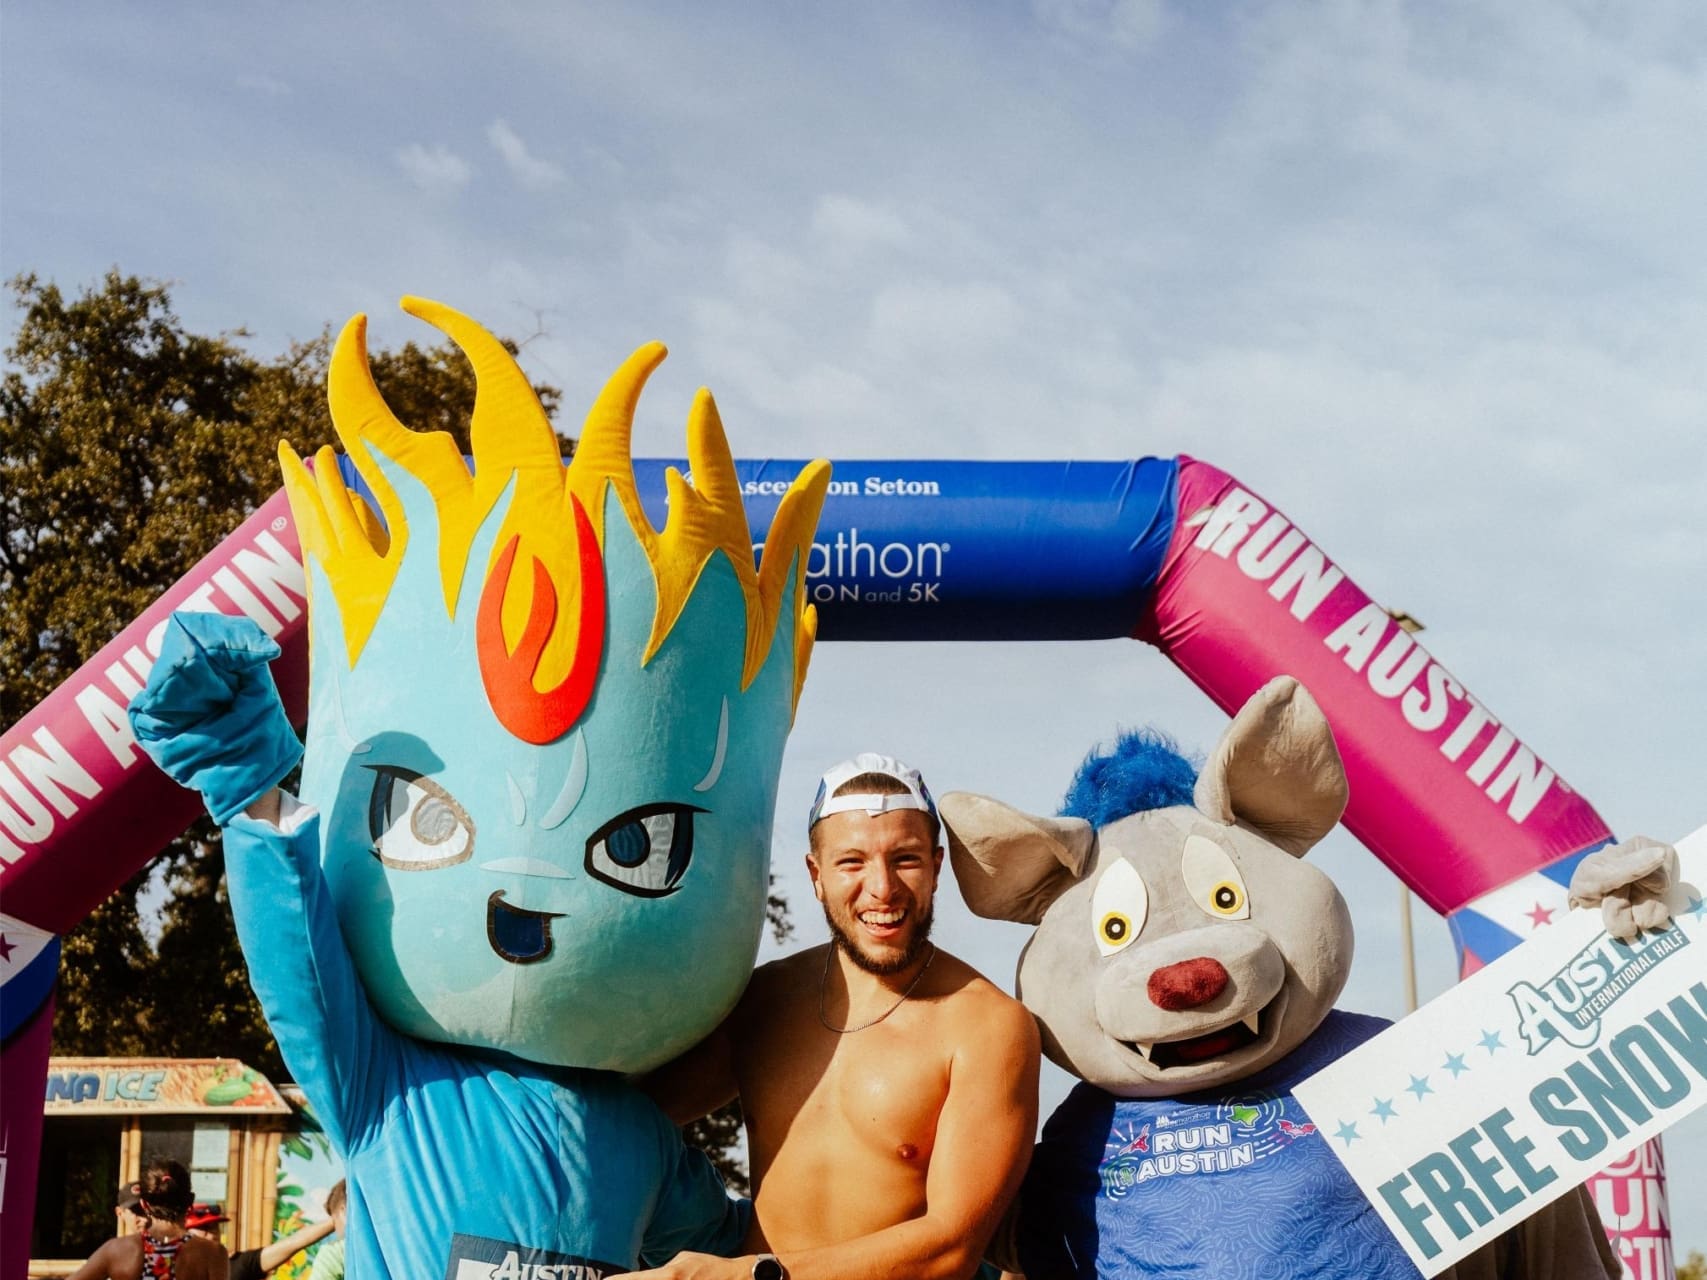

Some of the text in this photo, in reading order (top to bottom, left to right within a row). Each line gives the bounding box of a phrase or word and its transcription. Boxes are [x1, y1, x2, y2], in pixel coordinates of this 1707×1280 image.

[864, 476, 941, 496] Seton
[864, 585, 901, 603] and
[907, 582, 941, 603] 5K
[1187, 486, 1556, 824] RUN AUSTIN
[1575, 930, 1684, 1026] INTERNATIONAL HALF
[47, 1070, 166, 1104] NA ICE
[1152, 1123, 1232, 1155] RUN
[1136, 1142, 1254, 1183] AUSTIN
[1376, 1107, 1560, 1261] FREE
[1594, 1178, 1671, 1232] UN
